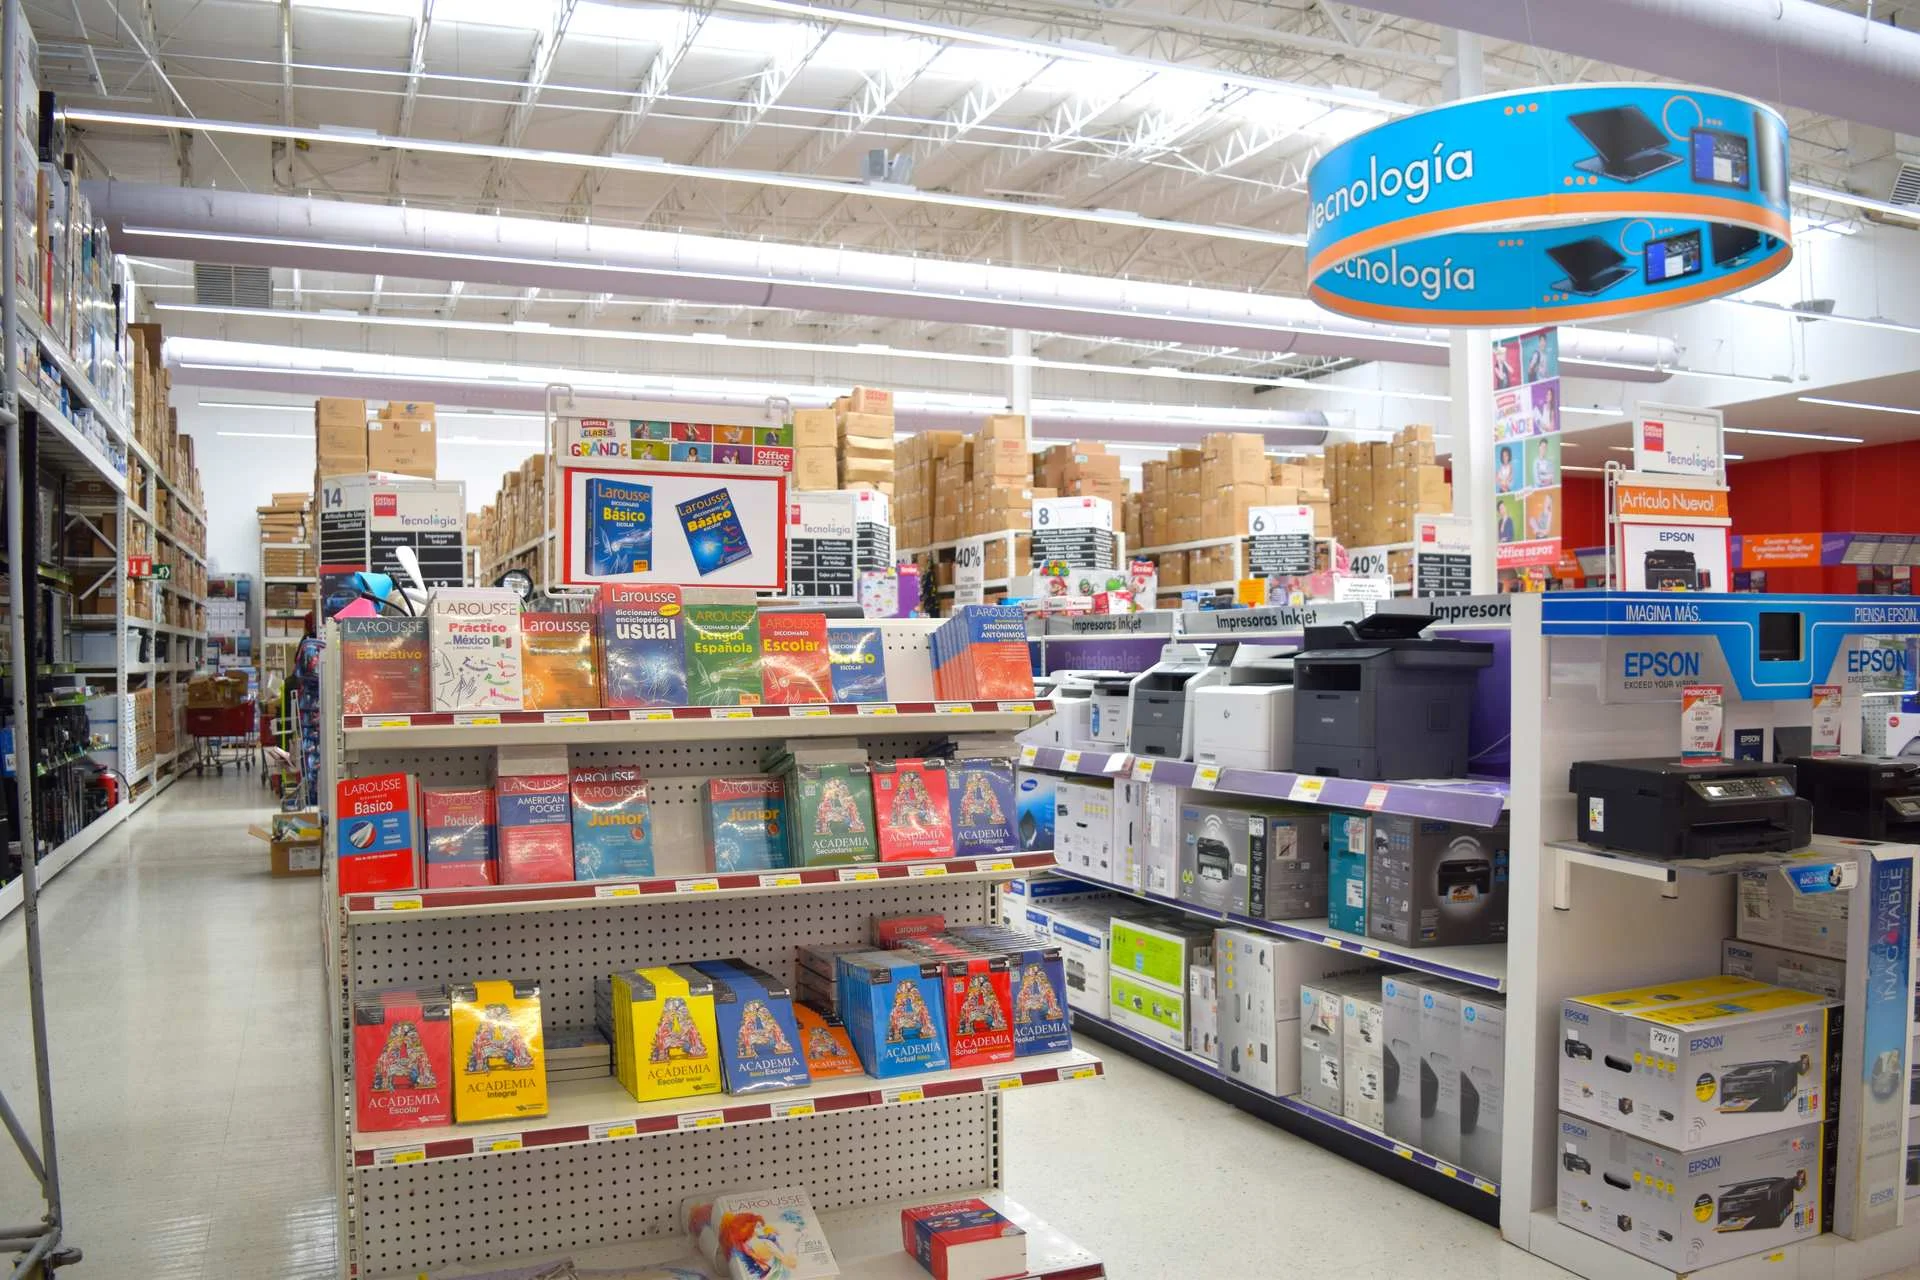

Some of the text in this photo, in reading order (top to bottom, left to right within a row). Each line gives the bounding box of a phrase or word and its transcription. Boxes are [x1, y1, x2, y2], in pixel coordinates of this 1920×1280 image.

[1311, 142, 1474, 230] ecnología
[571, 441, 628, 457] GRANDE
[757, 450, 790, 461] Office
[324, 488, 343, 508] 14
[597, 485, 650, 502] Larousse
[678, 493, 727, 517] Larousse
[1673, 494, 1715, 512] Nuevo!
[603, 507, 646, 523] Básico
[686, 510, 733, 533] Básico
[1039, 507, 1049, 525] 8
[1253, 515, 1265, 532] 6
[1659, 531, 1695, 543] EPSON
[957, 545, 981, 569] 40%
[1351, 555, 1385, 575] 40%
[612, 588, 677, 605] Larousse
[792, 584, 841, 596] 13 11
[437, 602, 517, 616] LAROUSSE
[615, 608, 658, 617] diccionario
[970, 606, 1024, 618] LAROUSSE
[1626, 602, 1701, 622] IMAGINA MÁS.
[1854, 607, 1918, 622] PIENSA EPSON.
[347, 621, 425, 634] LAROUSSE
[448, 621, 507, 634] Práctico
[521, 616, 590, 634] Larousse
[616, 615, 668, 625] enciclopédico
[983, 621, 1024, 631] SINÓNIMOS
[1072, 618, 1117, 635] Impresoras
[1217, 608, 1318, 633] Impresoras Inkjet
[617, 620, 676, 641] usual
[700, 630, 744, 645] Lengua
[980, 630, 1026, 639] ANTÓNIMOS
[452, 633, 491, 645] México
[763, 639, 820, 654] Escolar
[356, 648, 423, 661] Educativo
[695, 640, 752, 655] Española
[1064, 648, 1141, 671] Profesionales
[1624, 651, 1700, 678] EPSON
[1847, 650, 1907, 673] EPSON
[1624, 681, 1654, 690] EXCEED
[1655, 680, 1674, 689] YOUR
[1740, 735, 1761, 743] EPSON
[345, 778, 401, 797] LAROUSSE
[713, 781, 781, 794] LAROUSSE
[354, 799, 393, 815] Básico
[517, 796, 566, 805] AMERICAN
[530, 804, 565, 814] POCKET
[889, 829, 946, 843] ACADEMIA
[957, 829, 1010, 842] ACADEMIA
[978, 837, 1004, 845] Primaria
[812, 837, 870, 850] ACADEMIA
[816, 846, 853, 855] Secundaria
[895, 924, 929, 934] Larousse
[1728, 946, 1754, 959] EPSON
[1564, 1008, 1589, 1024] EPSON
[1013, 1022, 1068, 1038] ACADEMIA
[955, 1034, 1011, 1050] ACADEMIA
[1690, 1036, 1723, 1051] EPSON
[885, 1043, 942, 1059] ACADEMIA
[955, 1048, 979, 1056] School
[738, 1057, 801, 1073] ACADEMIA
[895, 1056, 917, 1065] Actual
[647, 1063, 712, 1081] ACADEMIA
[765, 1066, 792, 1076] Escolar
[467, 1078, 537, 1094] ACADEMIA
[657, 1076, 685, 1087] Escolar
[368, 1093, 441, 1109] ACADEMIA
[487, 1089, 518, 1099] Integral
[389, 1105, 420, 1115] Escolar
[1562, 1122, 1587, 1138] EPSON
[1688, 1157, 1721, 1174] EPSON
[728, 1193, 806, 1212] LAROUSSE
[1870, 1188, 1895, 1204] EPSON
